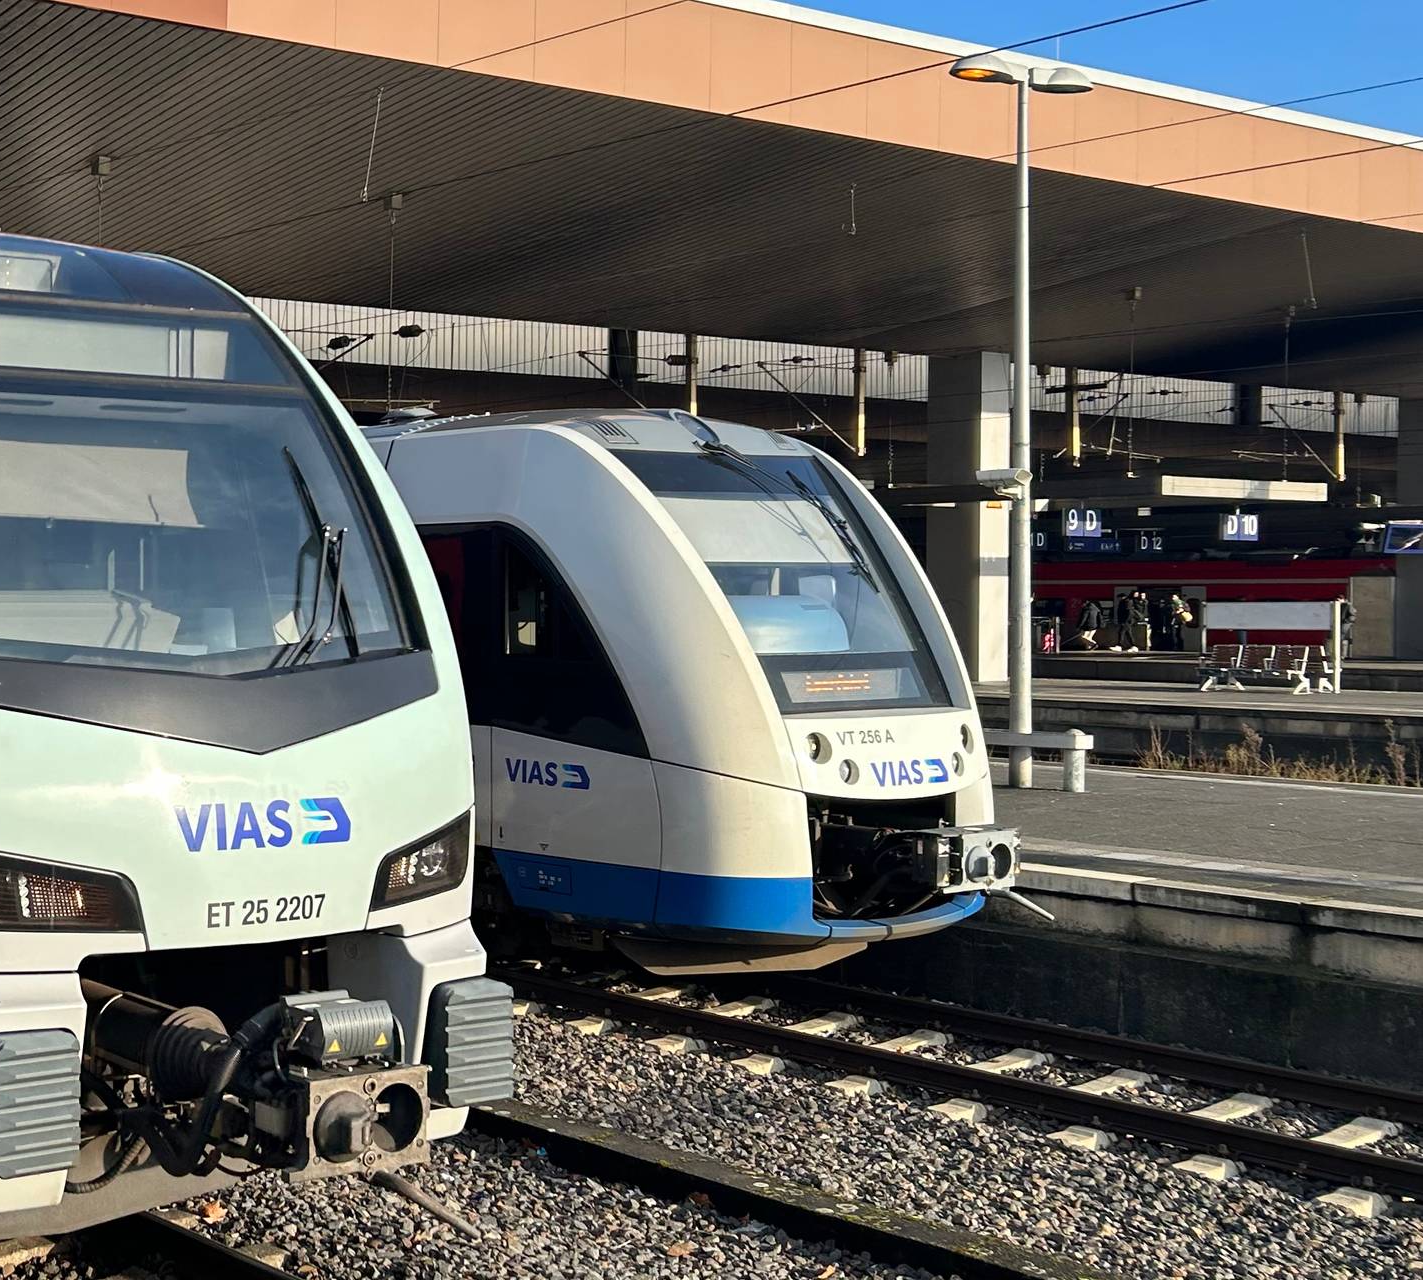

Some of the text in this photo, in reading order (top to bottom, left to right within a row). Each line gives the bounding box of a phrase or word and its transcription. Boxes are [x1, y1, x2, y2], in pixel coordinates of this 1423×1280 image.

[1068, 508, 1097, 531] 9 D
[1227, 515, 1258, 535] D 10
[1037, 532, 1045, 547] D
[1140, 536, 1163, 550] D 12
[836, 729, 895, 746] VT 256 A
[504, 757, 558, 787] VIAS
[870, 759, 924, 787] VIAS
[173, 799, 293, 852] VIAS
[207, 893, 326, 929] ET 25 2207
